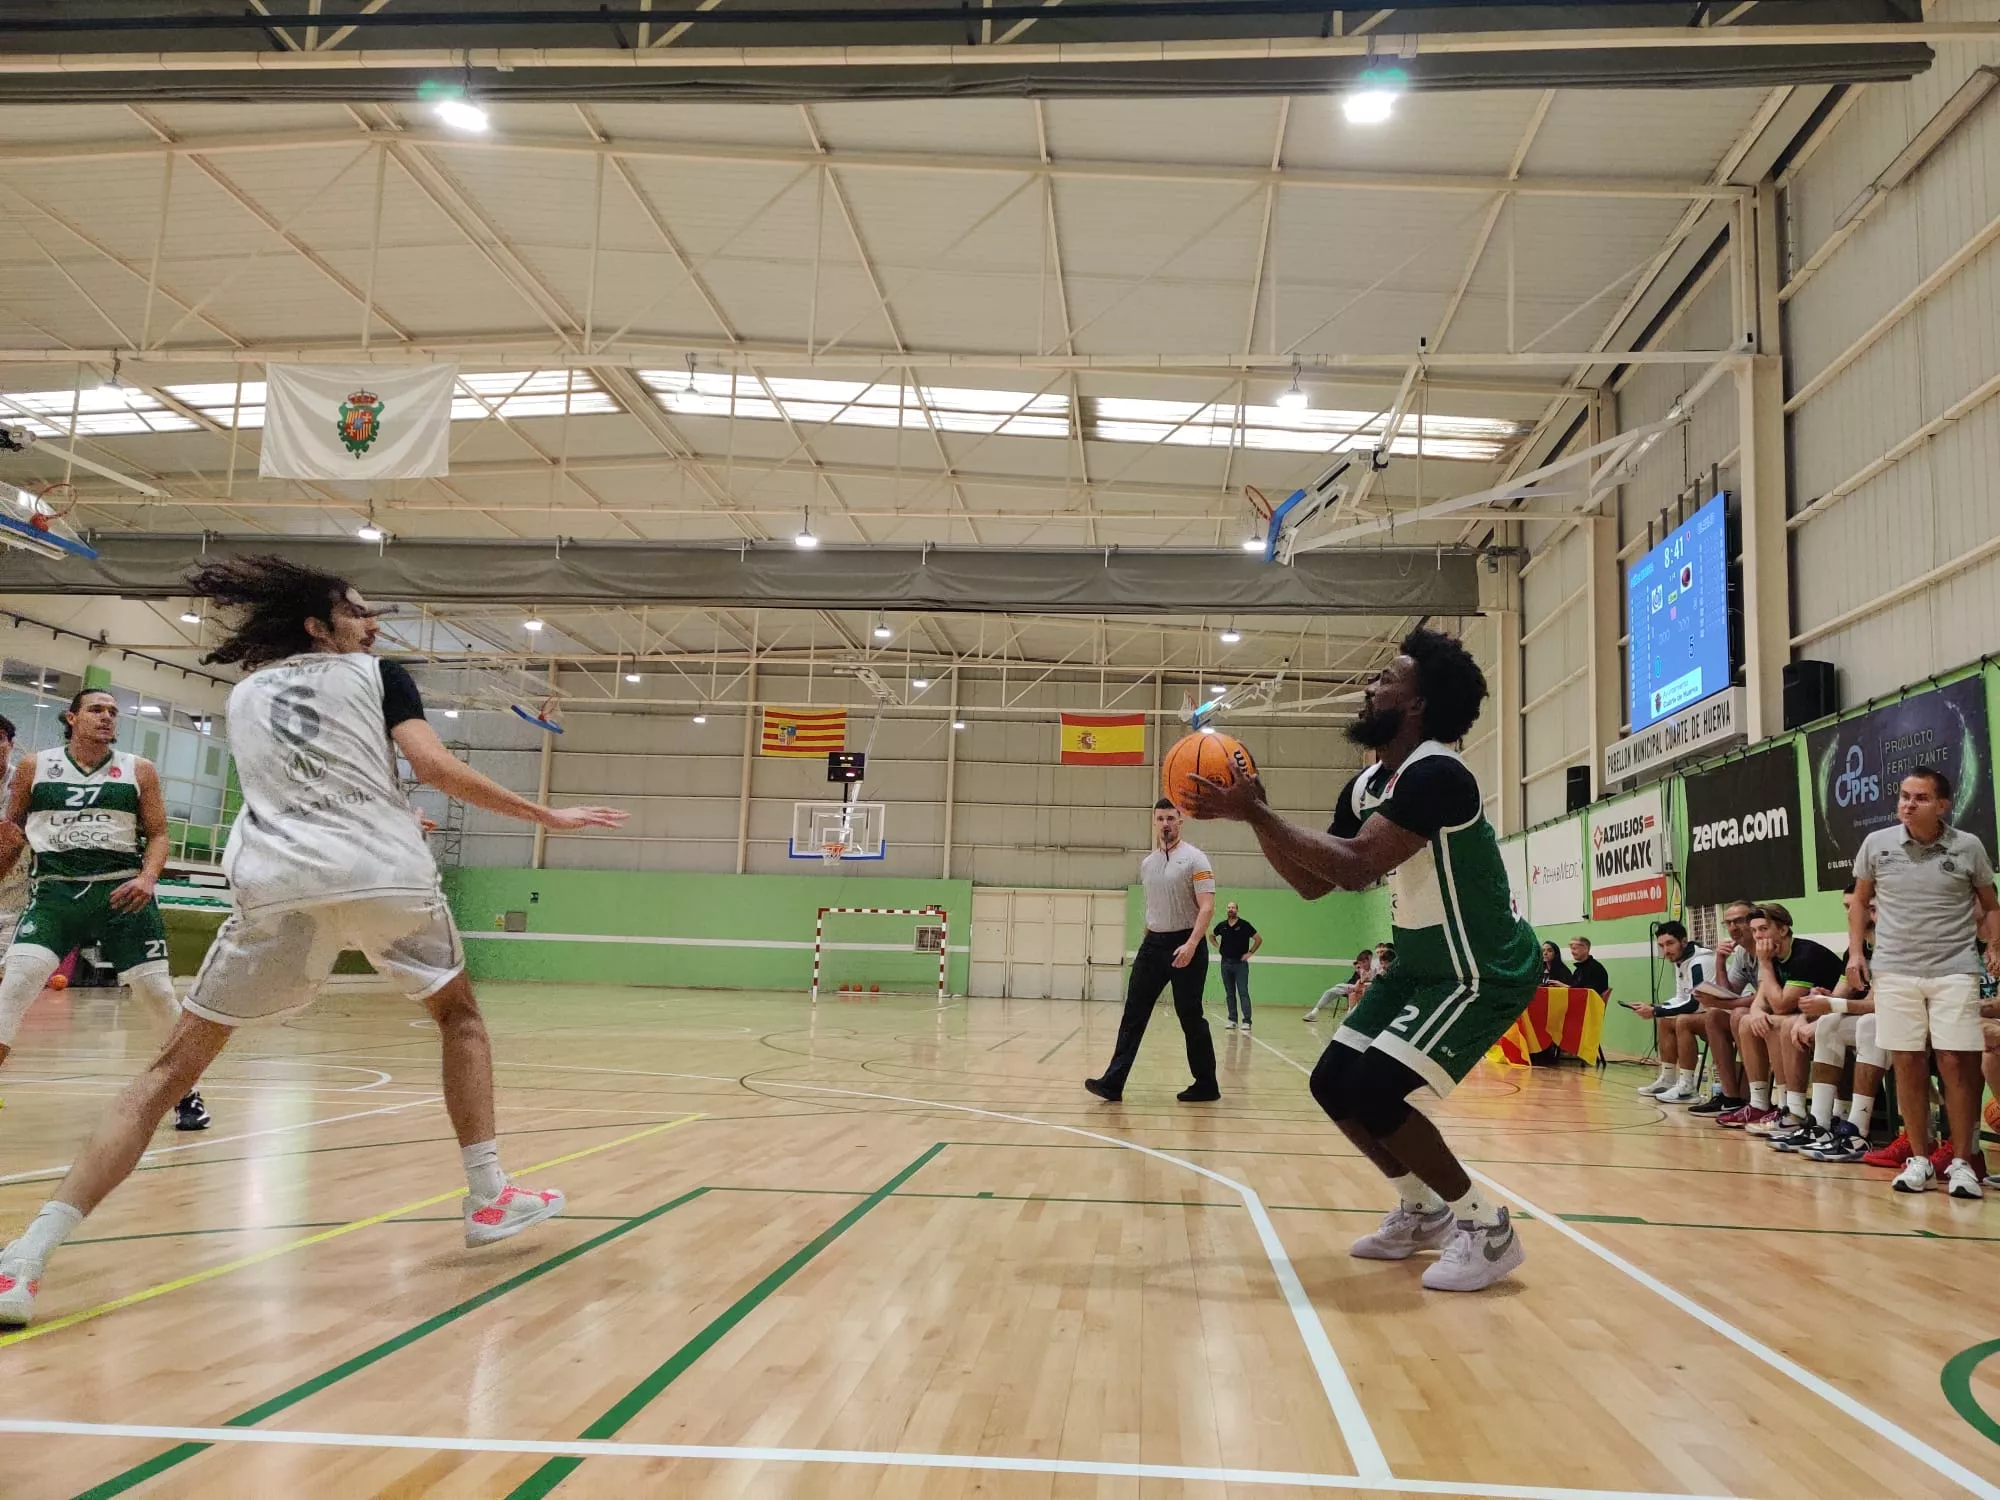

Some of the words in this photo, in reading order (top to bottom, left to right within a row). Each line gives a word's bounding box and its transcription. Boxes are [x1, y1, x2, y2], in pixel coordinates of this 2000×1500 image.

[1664, 536, 1684, 568] 8:41
[270, 685, 320, 746] 6
[1607, 746, 1631, 776] PABELLON
[1633, 731, 1662, 764] MUNICIPAL
[1666, 719, 1688, 751] CUARTE
[1692, 713, 1700, 740] DE
[1704, 699, 1731, 736] HUERVA
[1885, 729, 1933, 754] PRODUCTO
[65, 786, 102, 807] 27
[1603, 815, 1644, 845] AZULEJOS
[1693, 806, 1789, 853] zerca.com
[1389, 1004, 1420, 1033] 2
